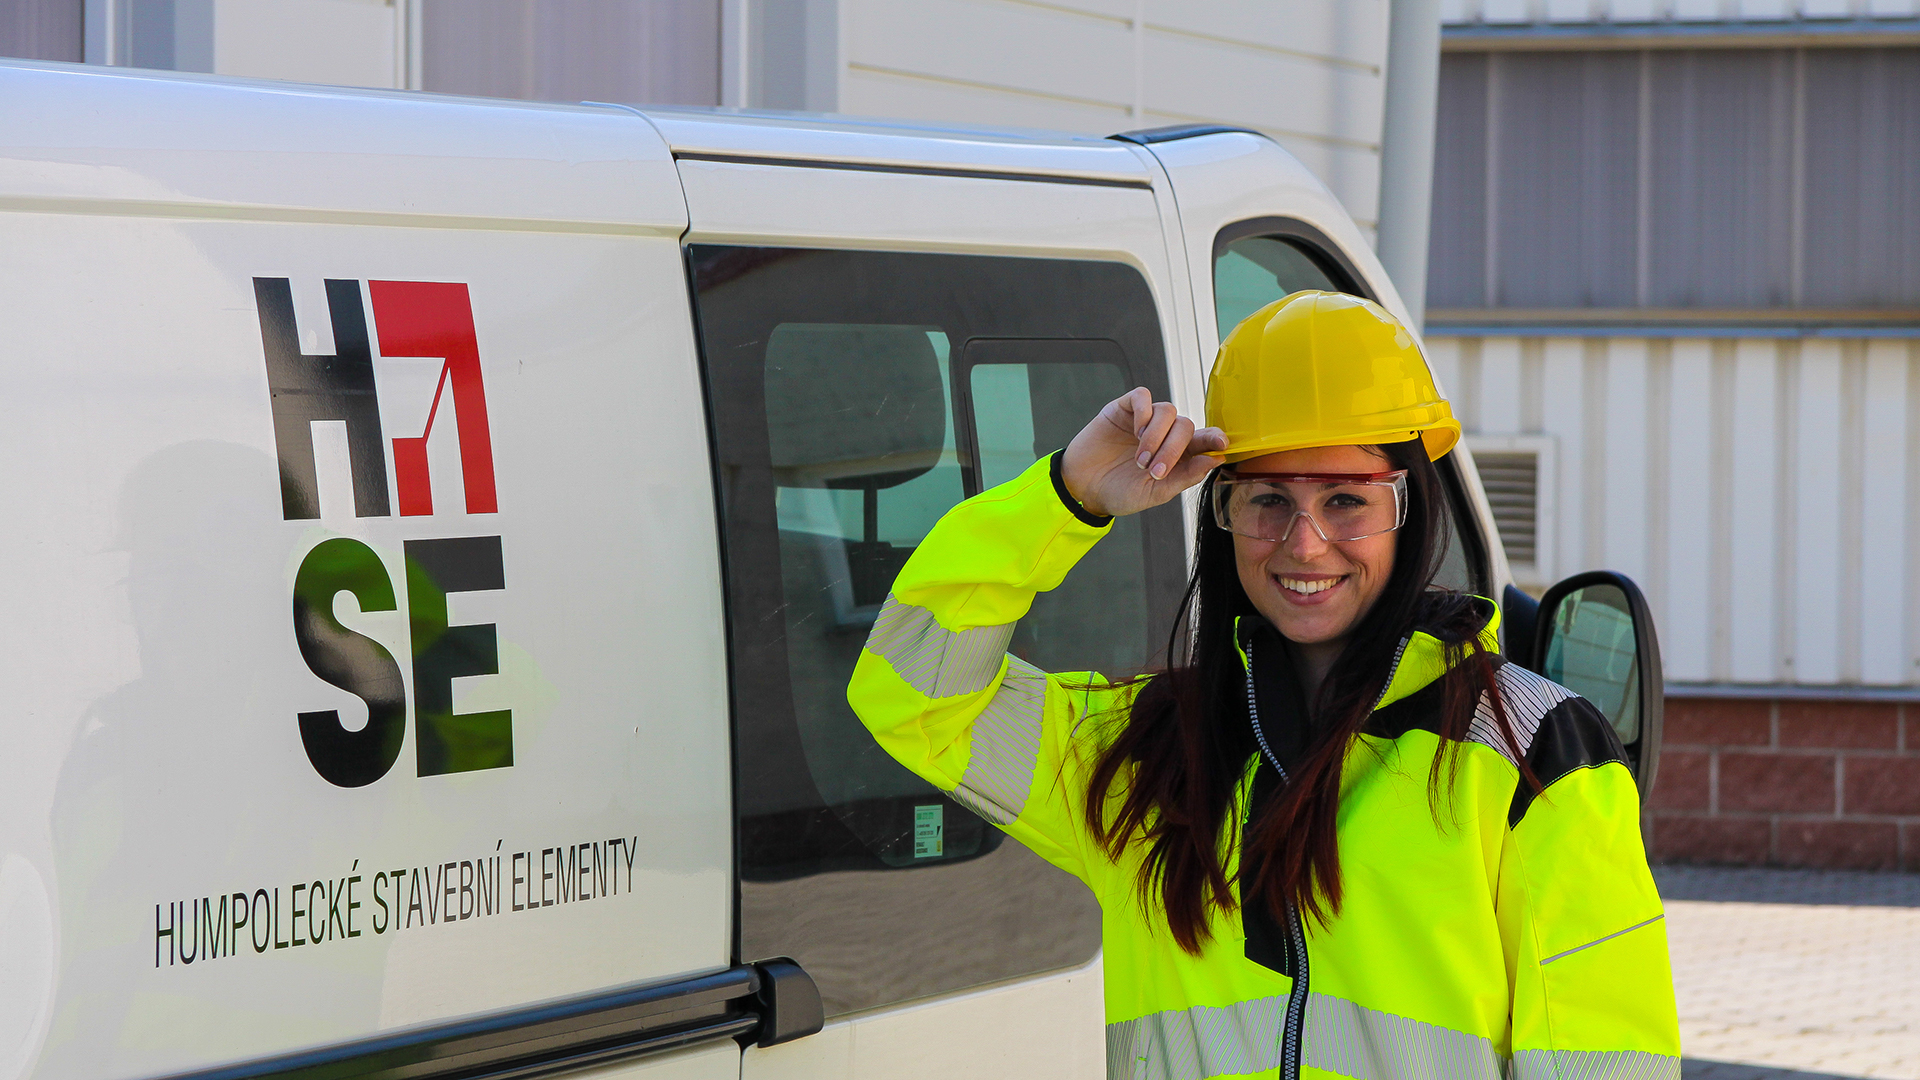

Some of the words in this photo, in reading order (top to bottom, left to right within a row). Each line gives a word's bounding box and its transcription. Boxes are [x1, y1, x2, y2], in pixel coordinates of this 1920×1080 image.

[292, 535, 514, 788] SE
[155, 859, 361, 968] HUMPOLECKÉ
[373, 839, 503, 935] STAVEBNÍ
[511, 836, 638, 912] ELEMENTY
